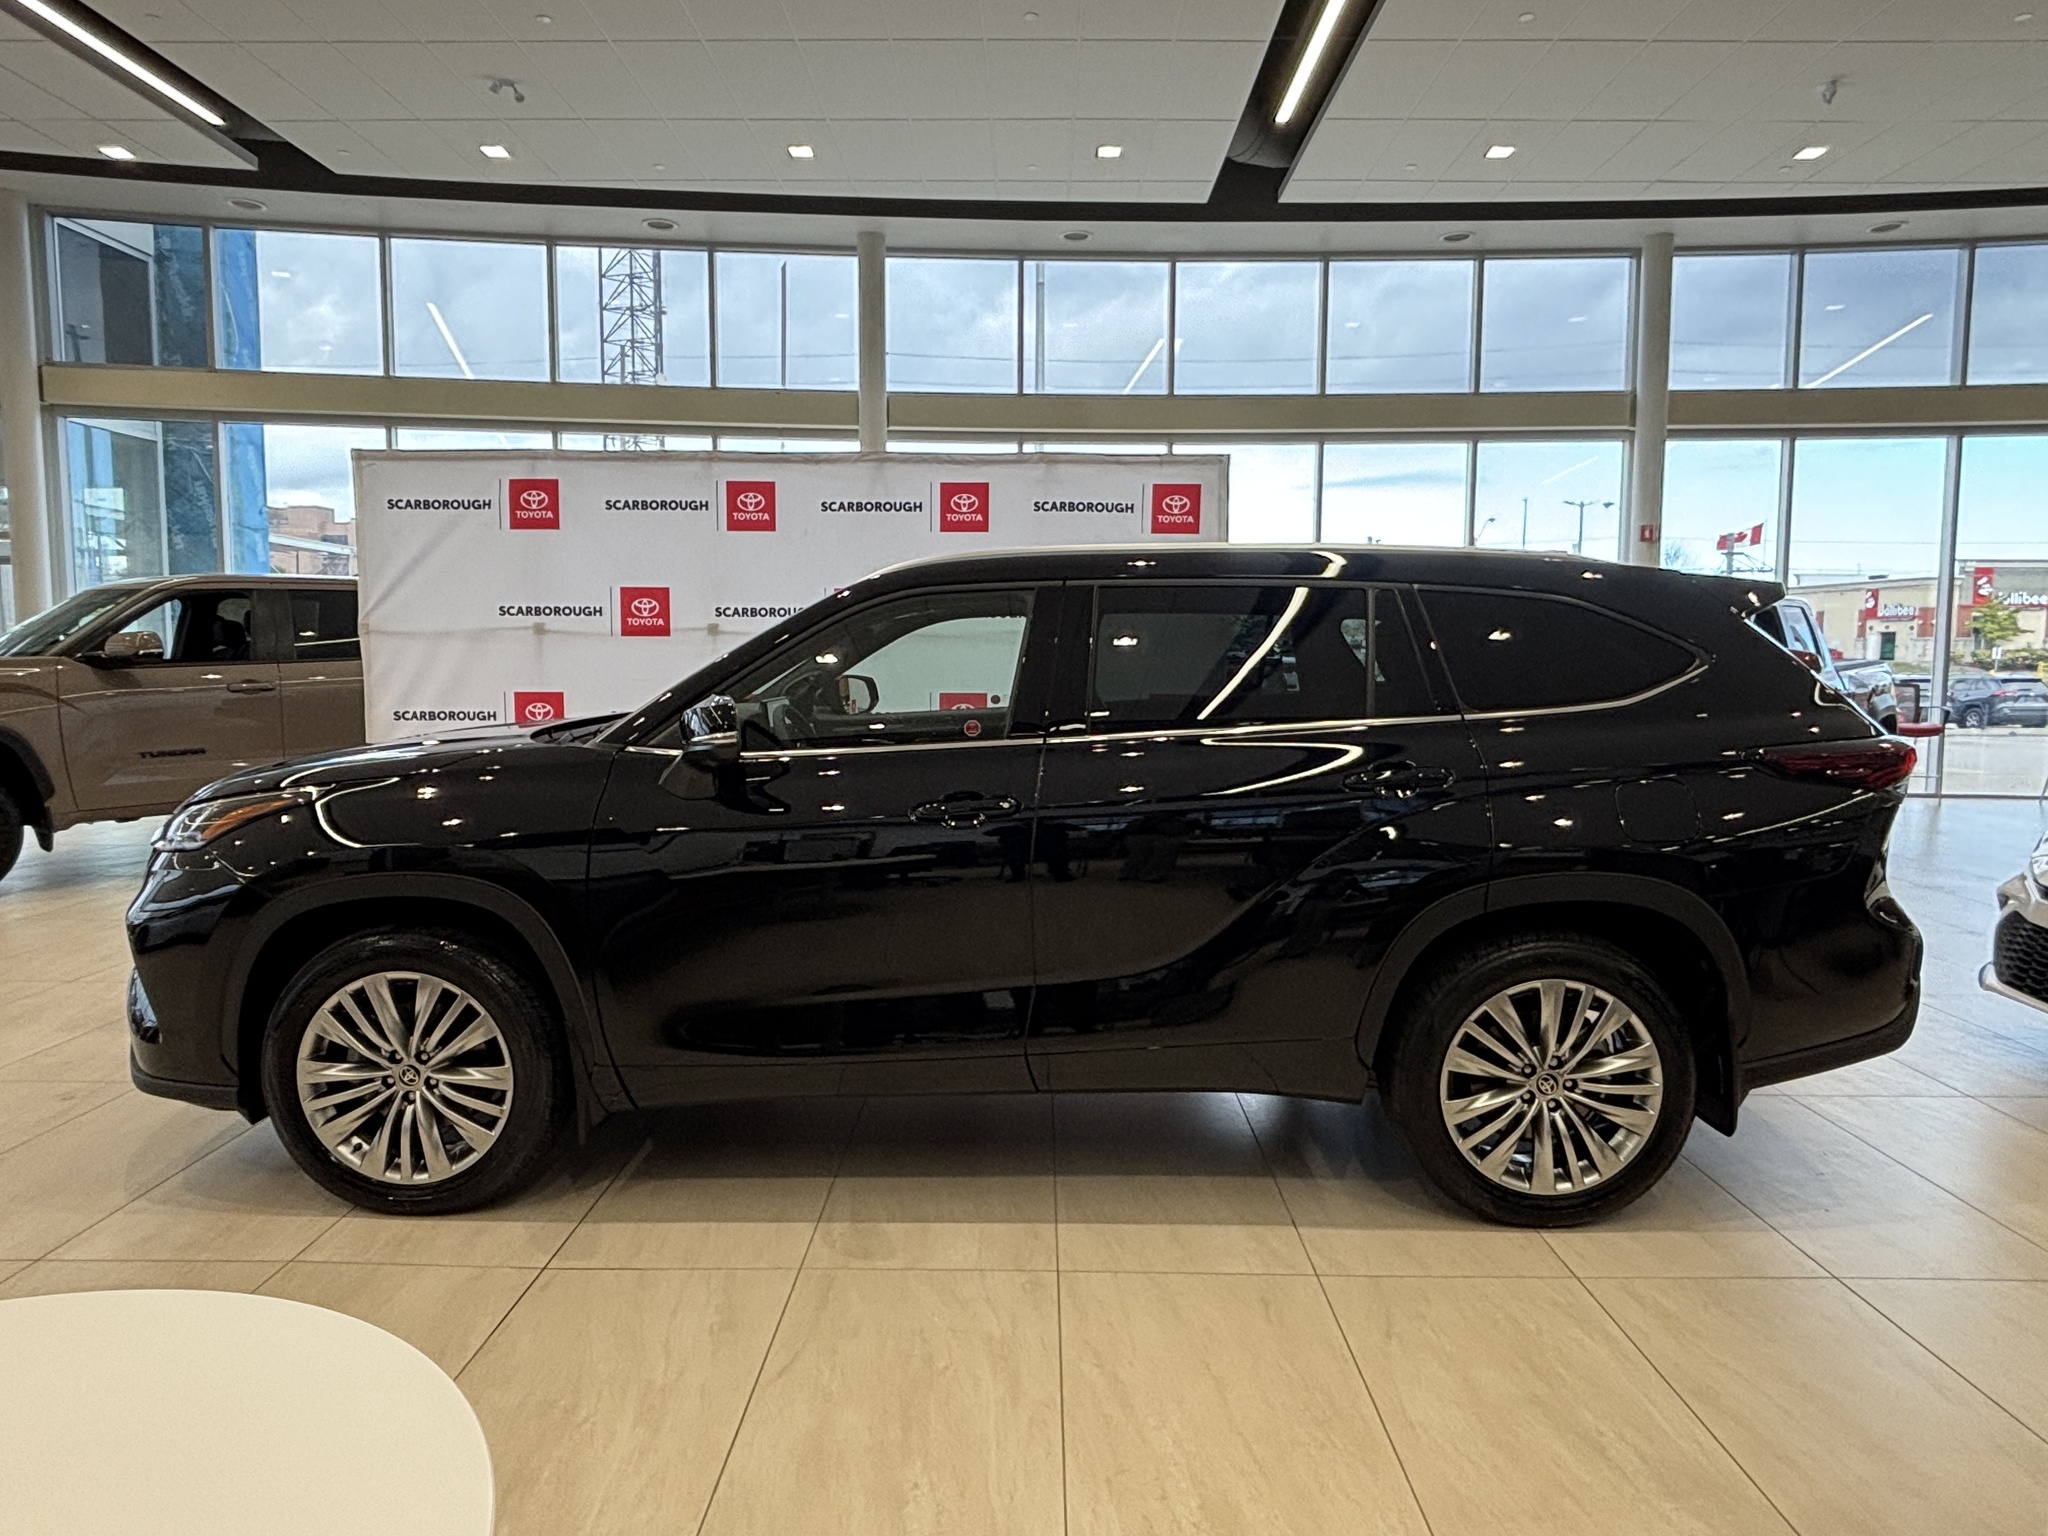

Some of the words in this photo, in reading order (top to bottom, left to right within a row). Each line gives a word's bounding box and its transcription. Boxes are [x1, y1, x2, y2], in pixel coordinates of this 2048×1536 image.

[387, 498, 492, 511] SCARBOROUGH
[515, 510, 554, 519] TOYOTA
[605, 499, 709, 512] SCARBOROUGH
[732, 512, 770, 521] TOYOTA
[820, 501, 923, 513] SCARBOROUGH
[945, 513, 983, 522] TOYOTA
[1033, 500, 1135, 515] SCARBOROUGH
[1157, 515, 1194, 524] TOYOTA
[498, 605, 603, 617] SCARBOROUGH
[626, 617, 665, 626] TOYOTA
[714, 606, 804, 618] SCARBOROU
[392, 709, 497, 722] SCARBOROUGH
